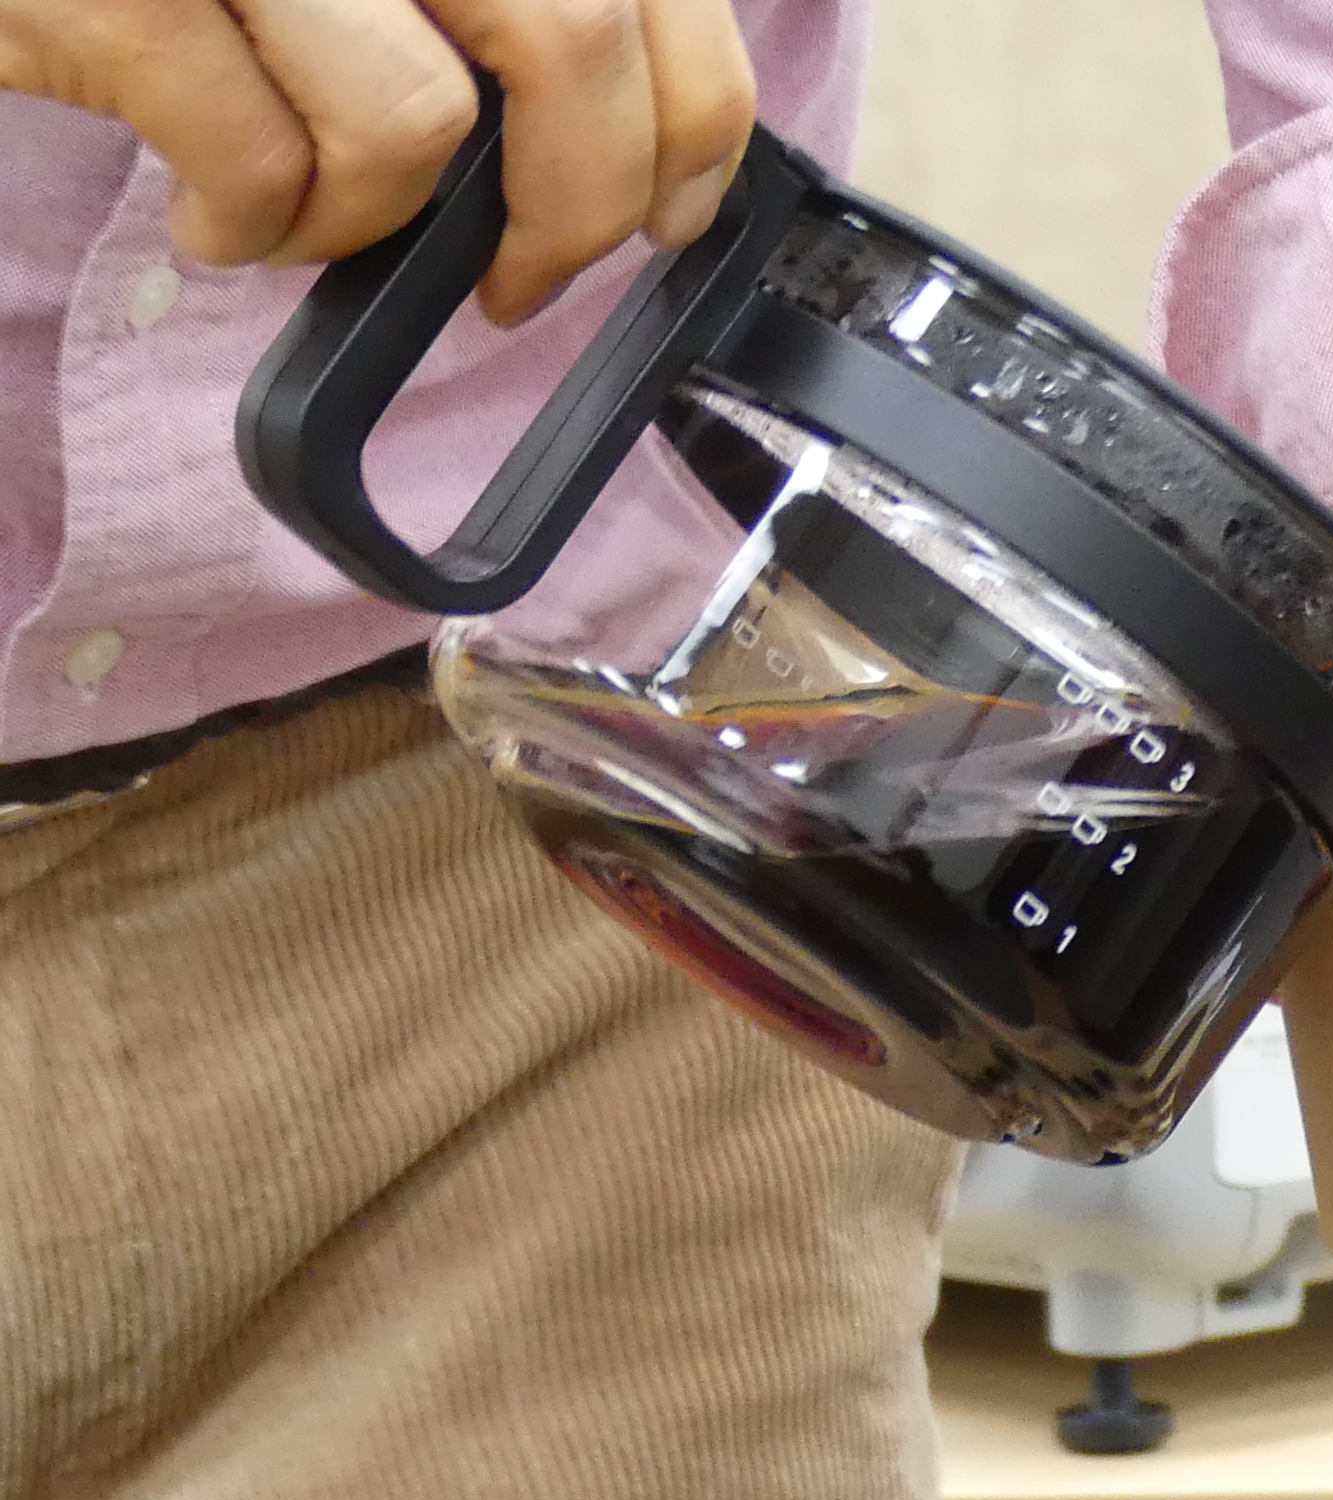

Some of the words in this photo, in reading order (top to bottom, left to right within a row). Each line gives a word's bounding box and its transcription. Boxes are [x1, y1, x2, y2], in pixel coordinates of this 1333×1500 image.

[1170, 761, 1195, 792] 3
[1111, 843, 1137, 875] 2
[1055, 925, 1077, 953] 1
